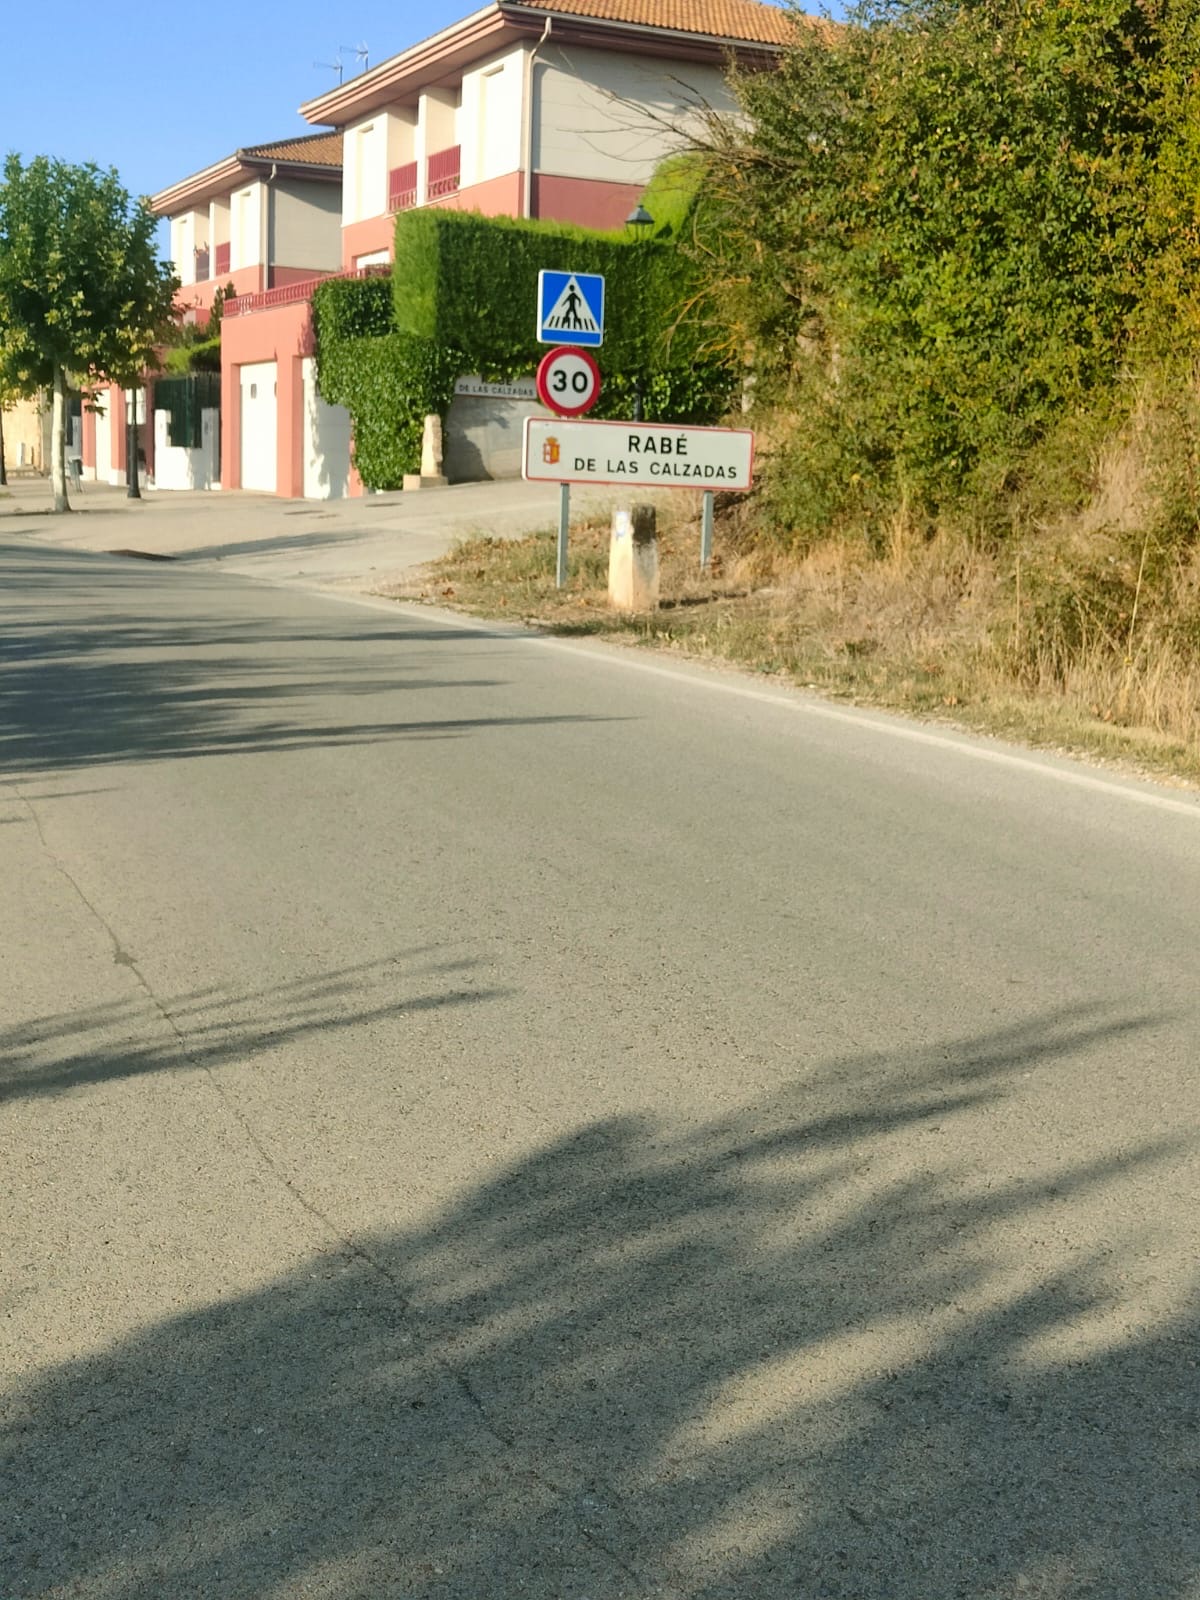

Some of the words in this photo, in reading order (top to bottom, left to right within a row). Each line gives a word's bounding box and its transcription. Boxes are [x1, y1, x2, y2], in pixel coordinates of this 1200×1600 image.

[458, 384, 469, 392] DE
[473, 385, 488, 393] LAS
[552, 370, 588, 393] 30
[628, 434, 688, 456] RABÉ
[574, 458, 596, 472] DE
[607, 459, 639, 474] LAS
[649, 461, 737, 479] CALZADAS
